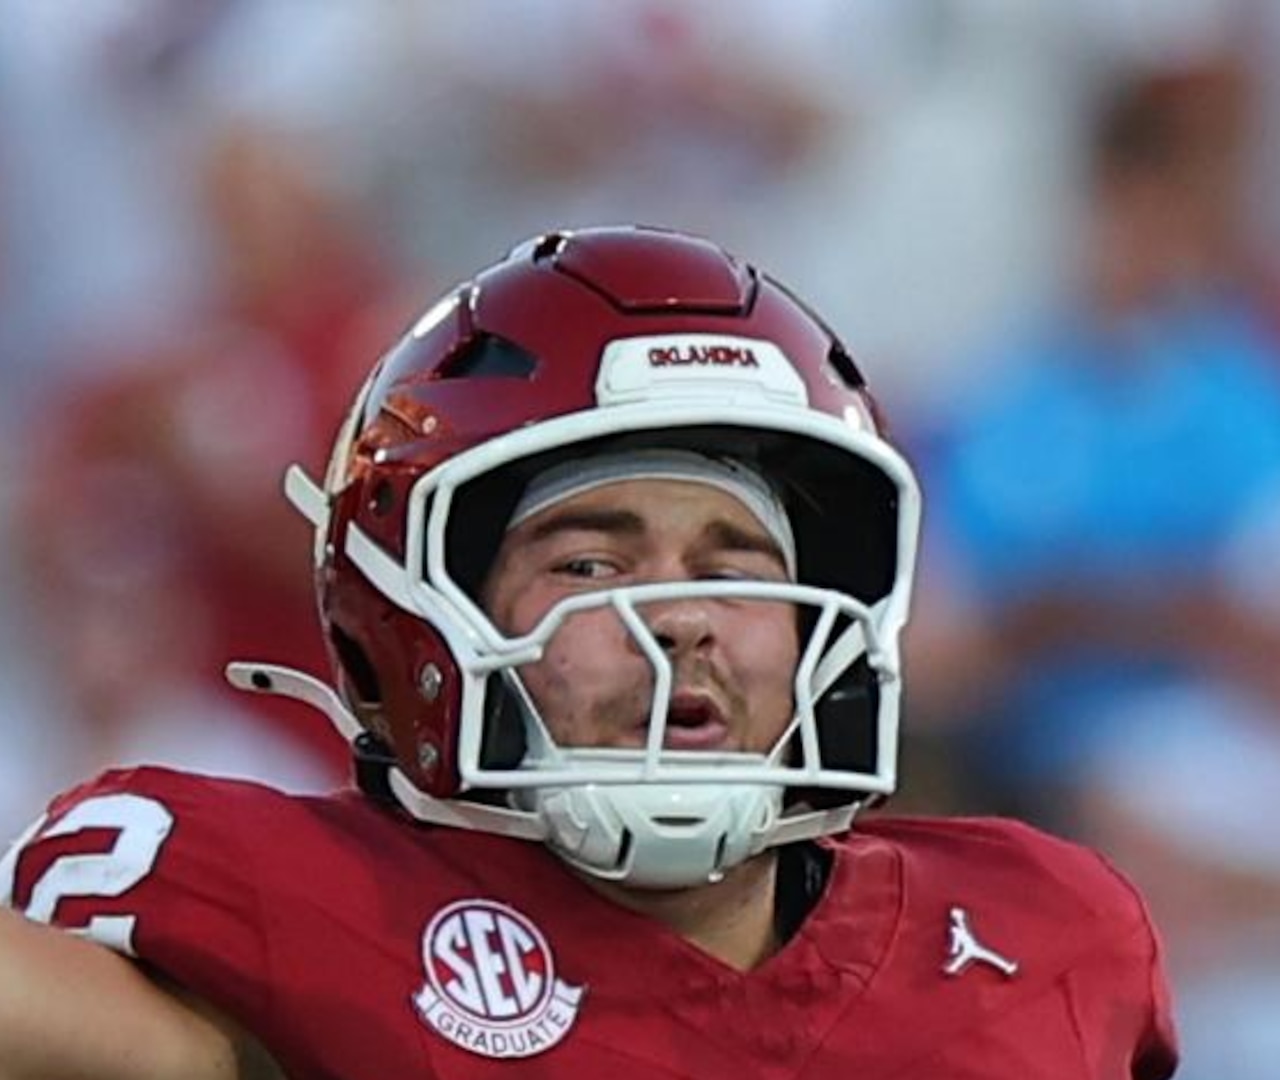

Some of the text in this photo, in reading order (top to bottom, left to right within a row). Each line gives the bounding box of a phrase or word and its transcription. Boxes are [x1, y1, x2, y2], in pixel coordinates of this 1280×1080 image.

[648, 345, 760, 368] OKLAHOMA
[432, 909, 544, 1017] SEC
[436, 1009, 568, 1054] GRADUATE
